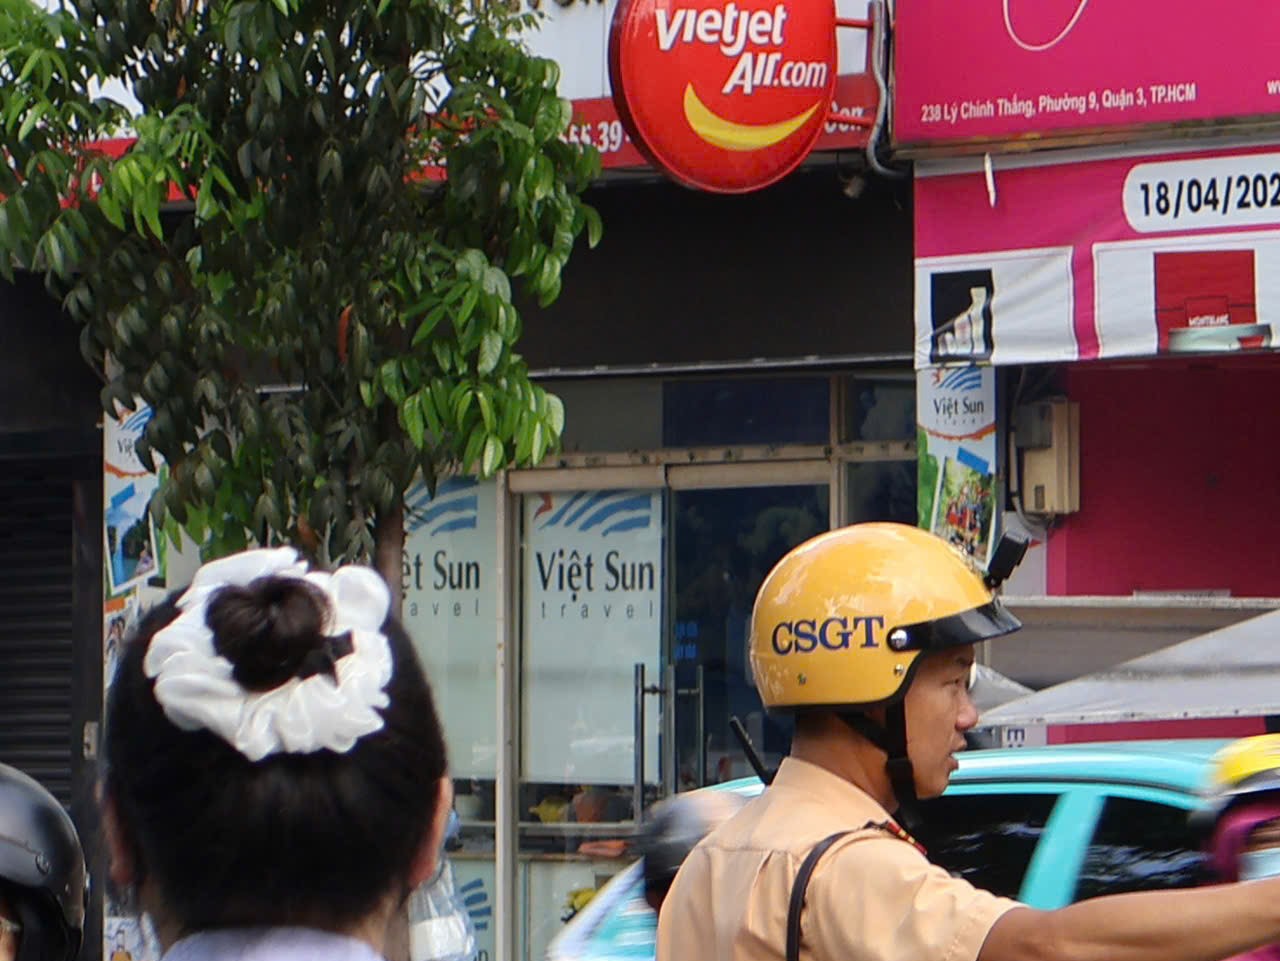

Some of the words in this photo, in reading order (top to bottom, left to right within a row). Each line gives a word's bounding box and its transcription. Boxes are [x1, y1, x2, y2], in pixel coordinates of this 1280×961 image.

[721, 52, 828, 95] Air.com
[921, 104, 941, 122] 238
[943, 103, 958, 124] Lý
[1088, 90, 1099, 111] 9,
[1102, 87, 1134, 111] Quận
[1136, 86, 1147, 107] 3,
[1150, 82, 1197, 103] TP.HCM
[933, 398, 958, 418] Việt
[962, 398, 984, 414] Sun
[433, 550, 480, 591] Sun
[536, 550, 594, 602] Việt
[604, 550, 654, 592] Sun
[410, 598, 479, 617] avel
[541, 600, 654, 619] travel
[771, 615, 885, 655] CSGT
